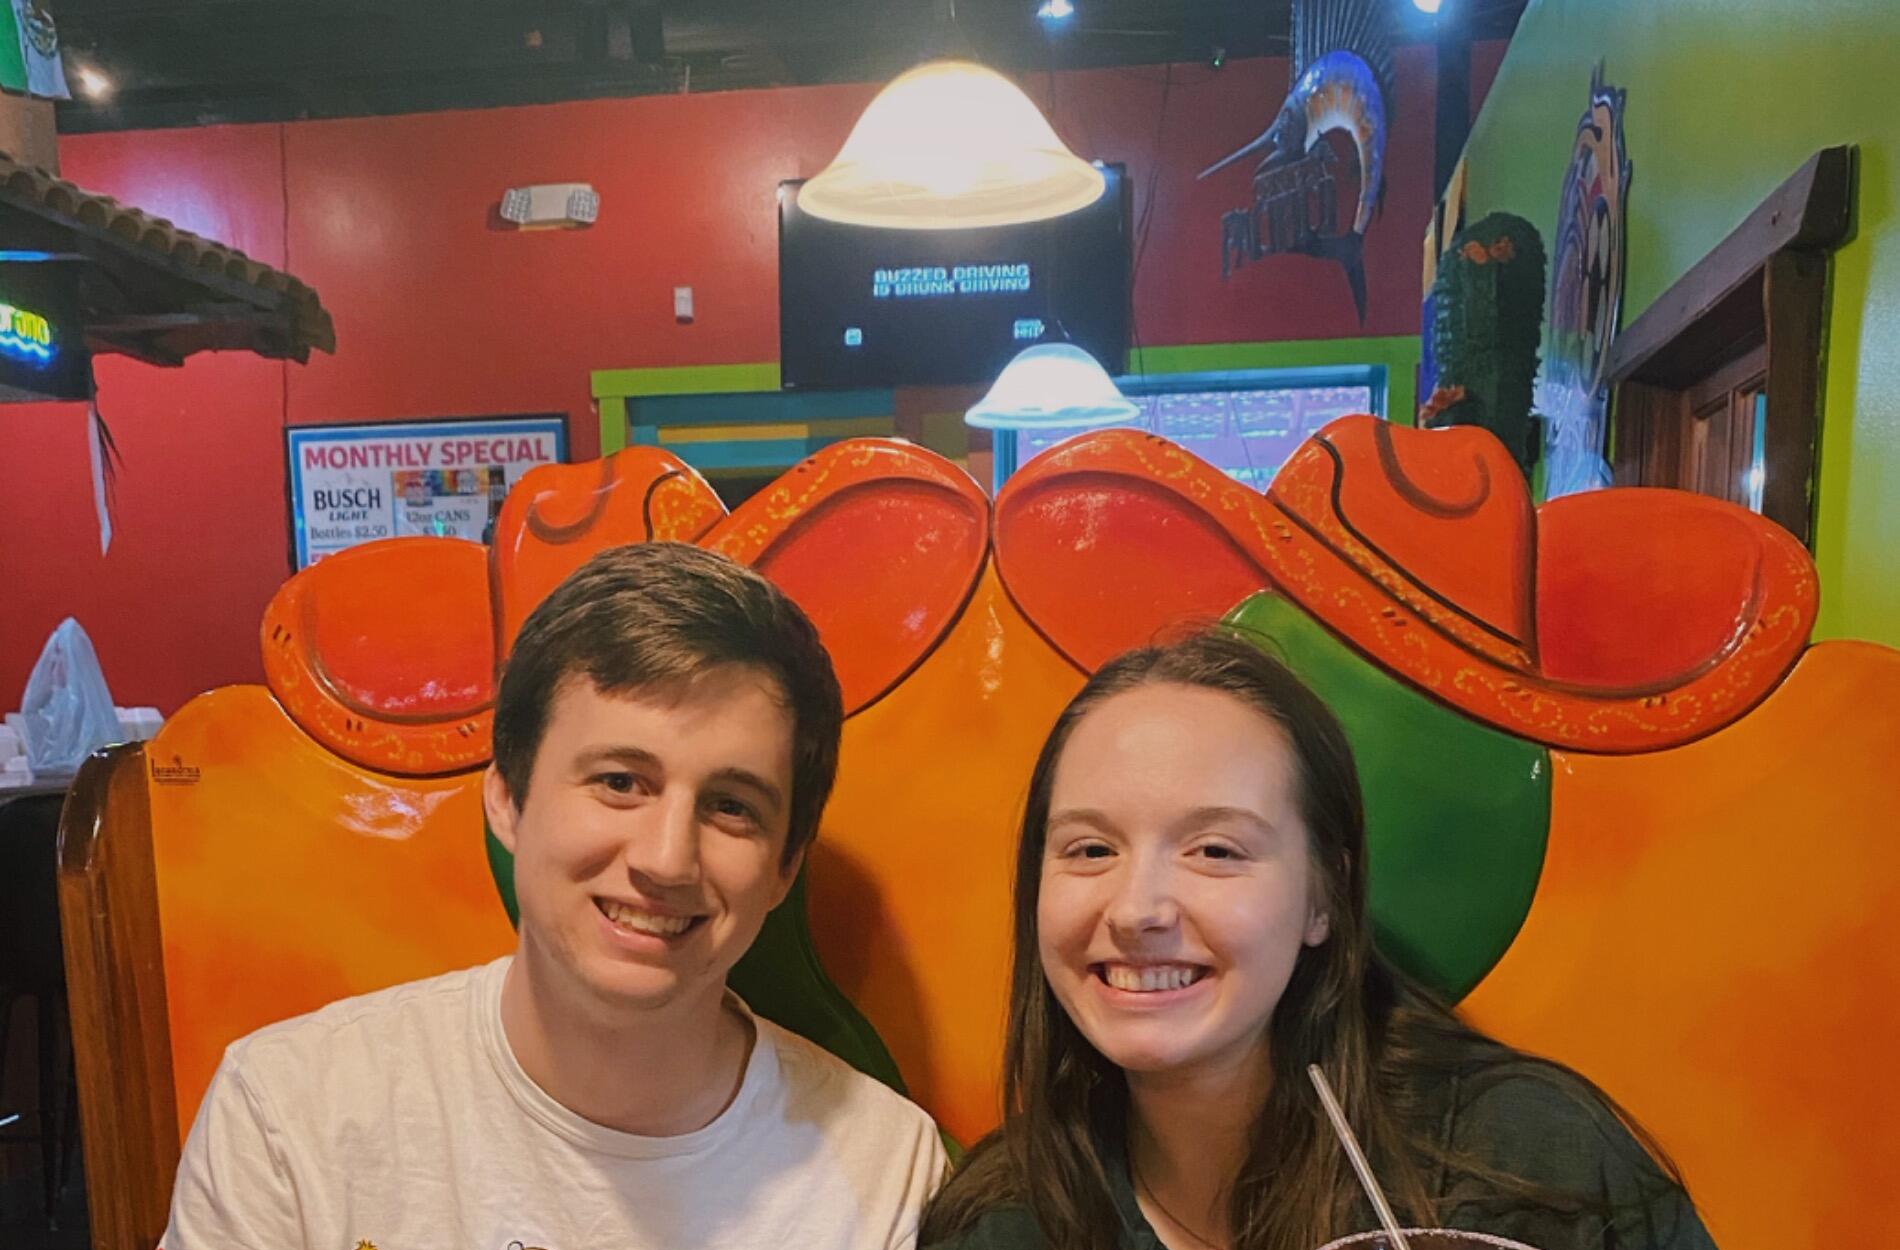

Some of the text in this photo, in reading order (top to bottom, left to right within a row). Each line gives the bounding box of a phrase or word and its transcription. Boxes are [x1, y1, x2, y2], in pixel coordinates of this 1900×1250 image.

[874, 263, 1030, 283] BUZZED DRIVING
[304, 437, 549, 471] MONTHLY SPECIAL
[313, 488, 382, 512] BUSCH
[328, 510, 369, 522] LIGHT
[434, 510, 471, 522] CANS
